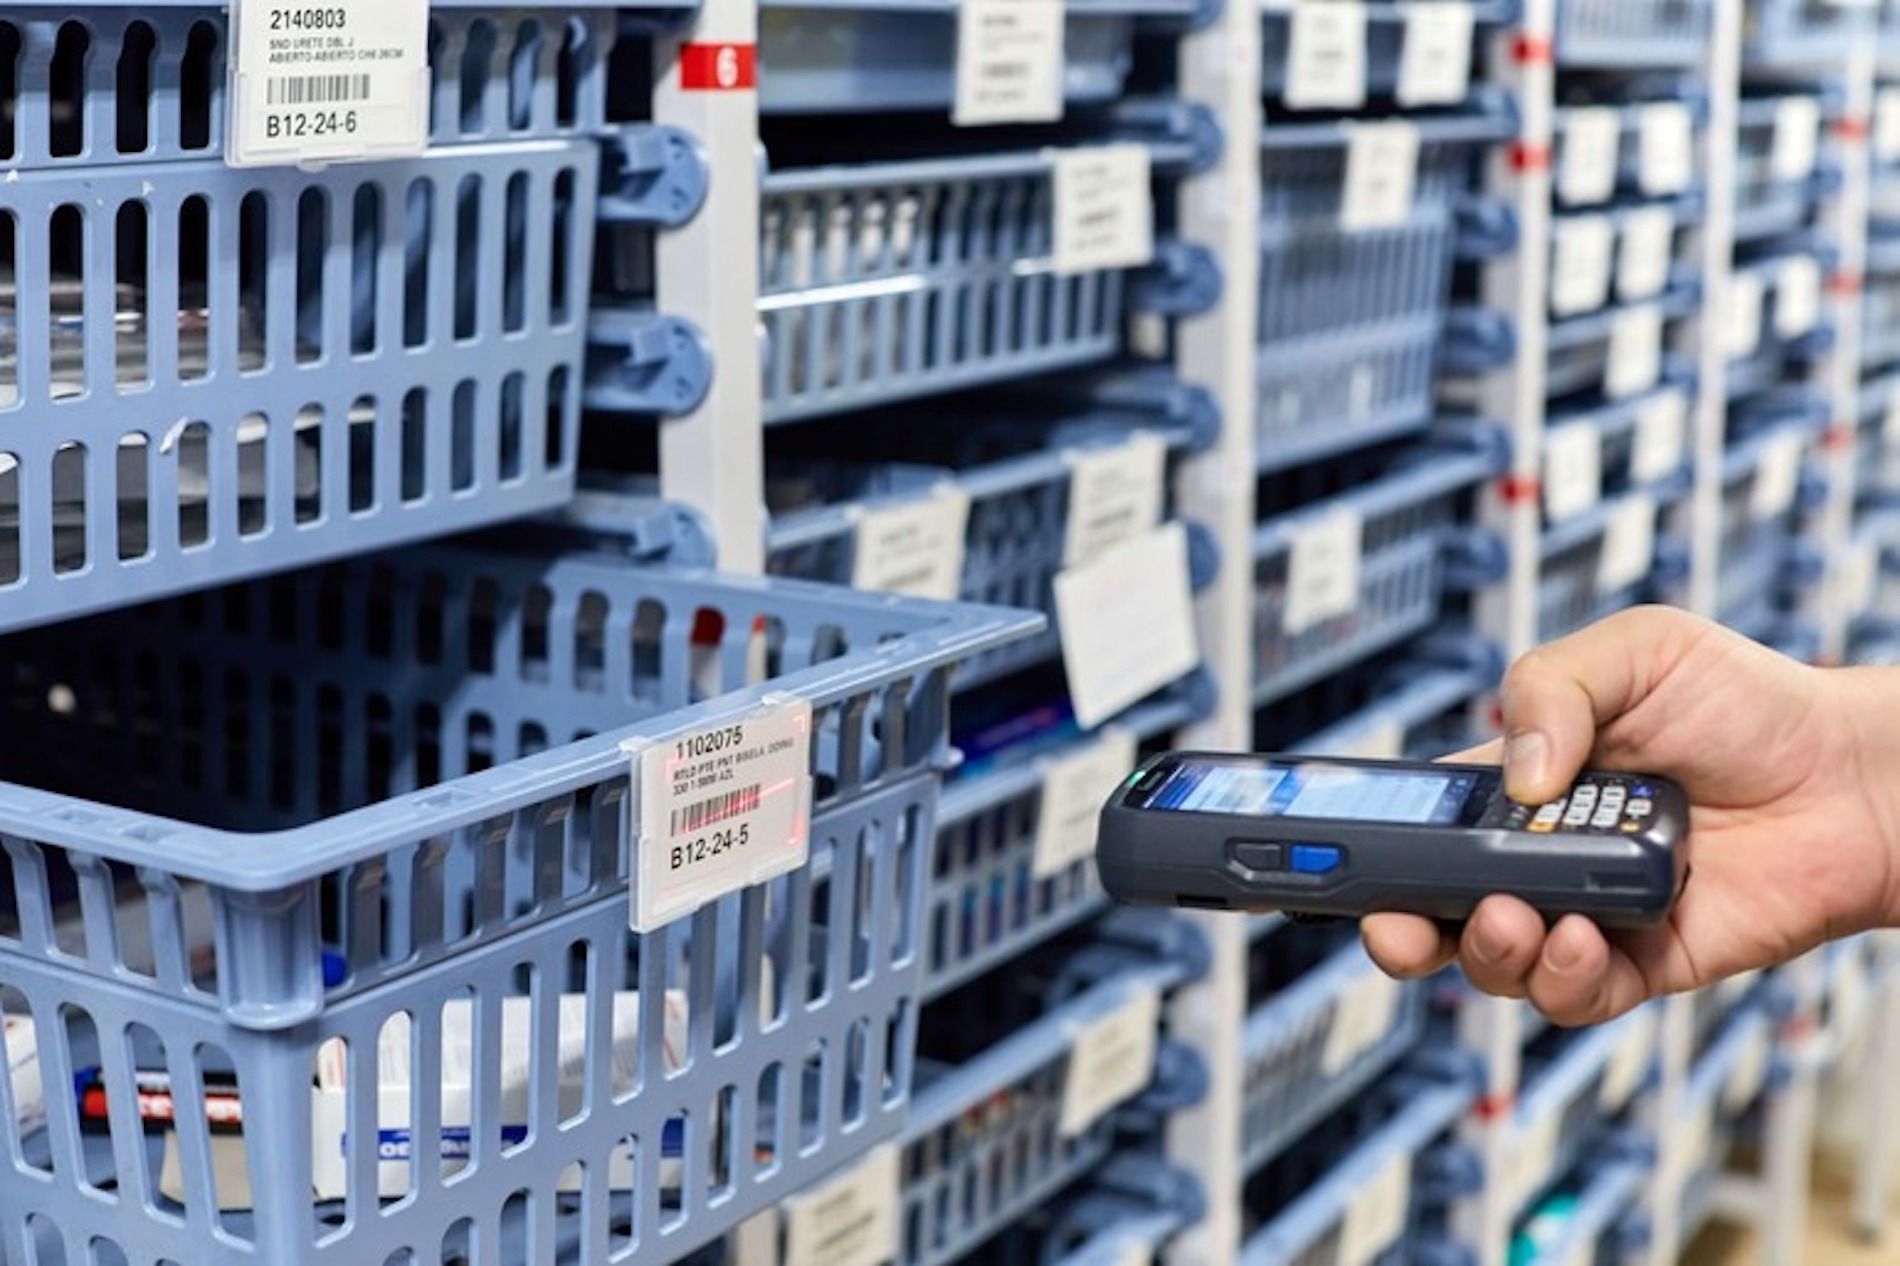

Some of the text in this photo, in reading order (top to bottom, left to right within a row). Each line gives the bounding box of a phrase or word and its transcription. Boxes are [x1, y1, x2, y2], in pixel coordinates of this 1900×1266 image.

[270, 9, 347, 30] 2140803
[717, 46, 738, 87] 6
[266, 111, 357, 138] B12-24-6
[675, 725, 744, 760] 1102075
[670, 823, 750, 869] B12-24-5
